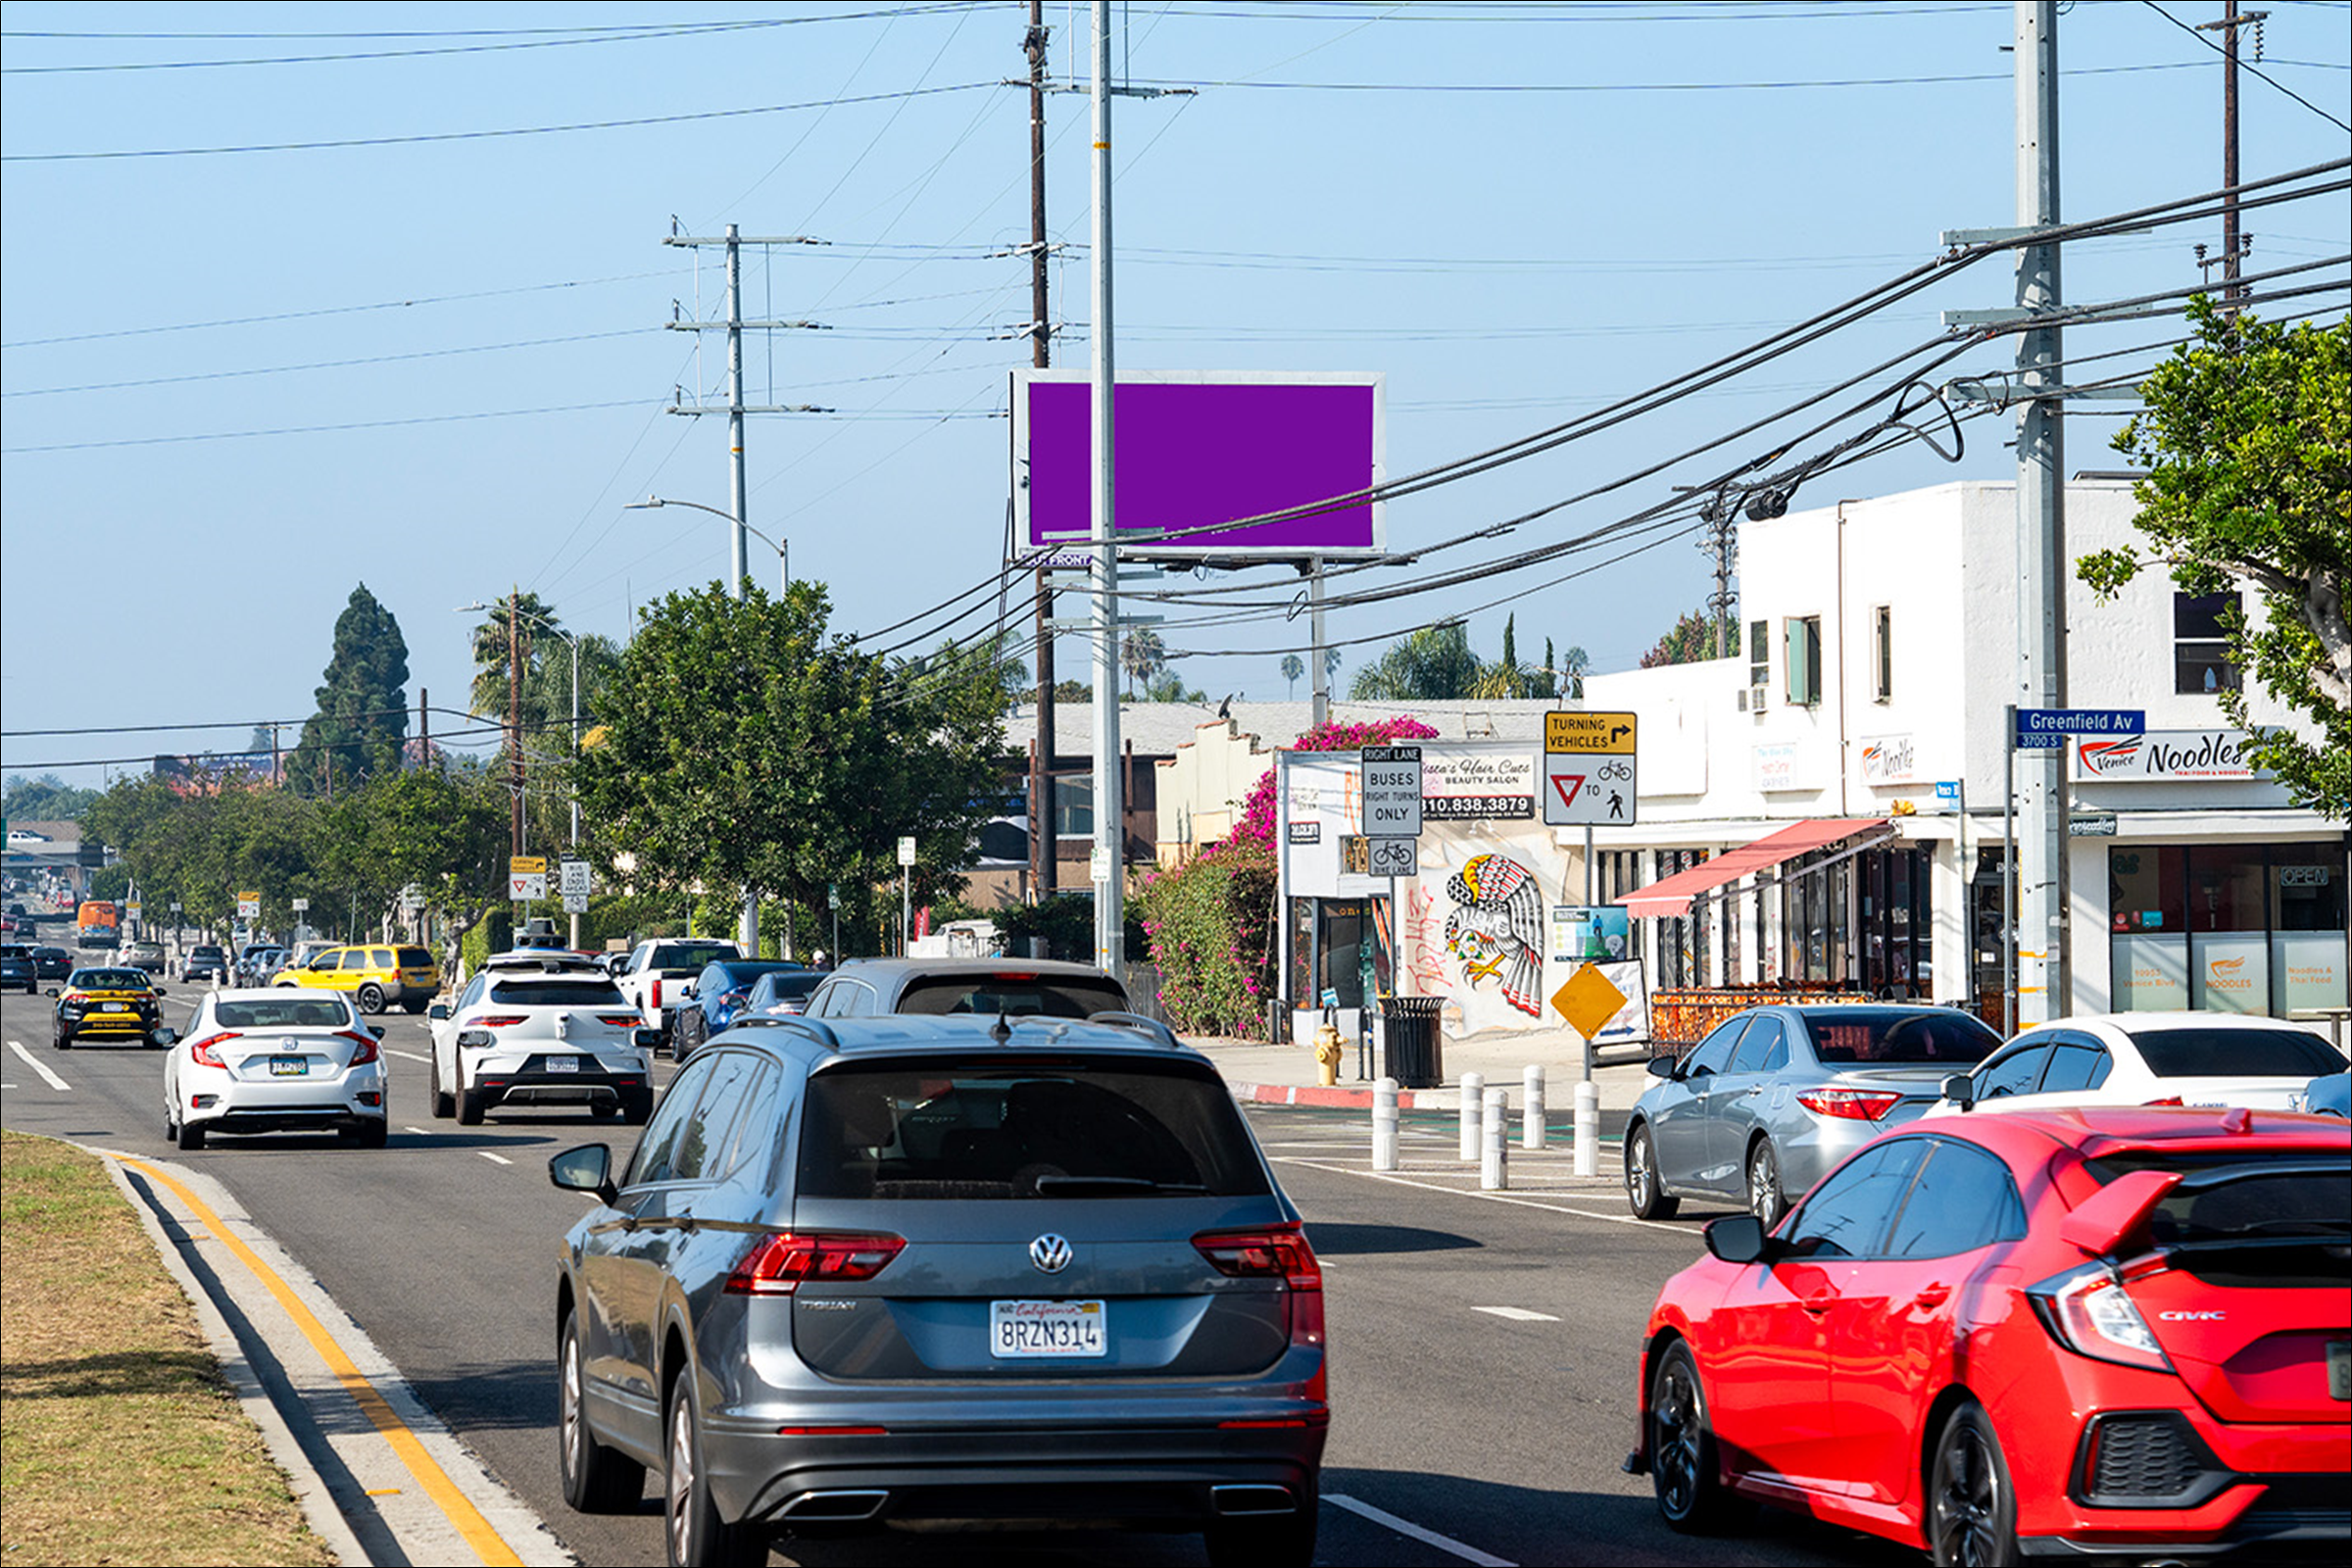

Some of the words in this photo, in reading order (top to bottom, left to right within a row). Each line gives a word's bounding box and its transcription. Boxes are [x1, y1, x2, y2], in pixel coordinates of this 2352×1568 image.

[1552, 718, 1605, 731] TURNING
[2031, 712, 2108, 730] Greenfield
[2114, 714, 2132, 730] Av
[1549, 736, 1608, 748] VEHICLES
[2022, 735, 2047, 747] 3700
[2050, 735, 2058, 747] S
[1364, 749, 1392, 760] RIGHT
[1394, 749, 1419, 760] LANE
[2096, 754, 2134, 770] Venice
[2146, 733, 2244, 773] Noodles
[1459, 759, 1495, 774] Hair
[1498, 759, 1531, 774] Cuts
[1370, 772, 1414, 786] BUSES
[1486, 775, 1519, 784] SALON
[1366, 791, 1389, 802] RIGHT
[1393, 791, 1418, 802] TURNS
[1586, 784, 1600, 797] TO
[1375, 808, 1409, 821] ONLY
[2283, 868, 2327, 883] OPEN
[2205, 978, 2252, 989] NOODLES
[800, 1300, 857, 1310] TIGUAN
[1015, 1302, 1078, 1319] California
[2159, 1311, 2226, 1321] CIVIC
[1002, 1319, 1098, 1348] 8RZN314
